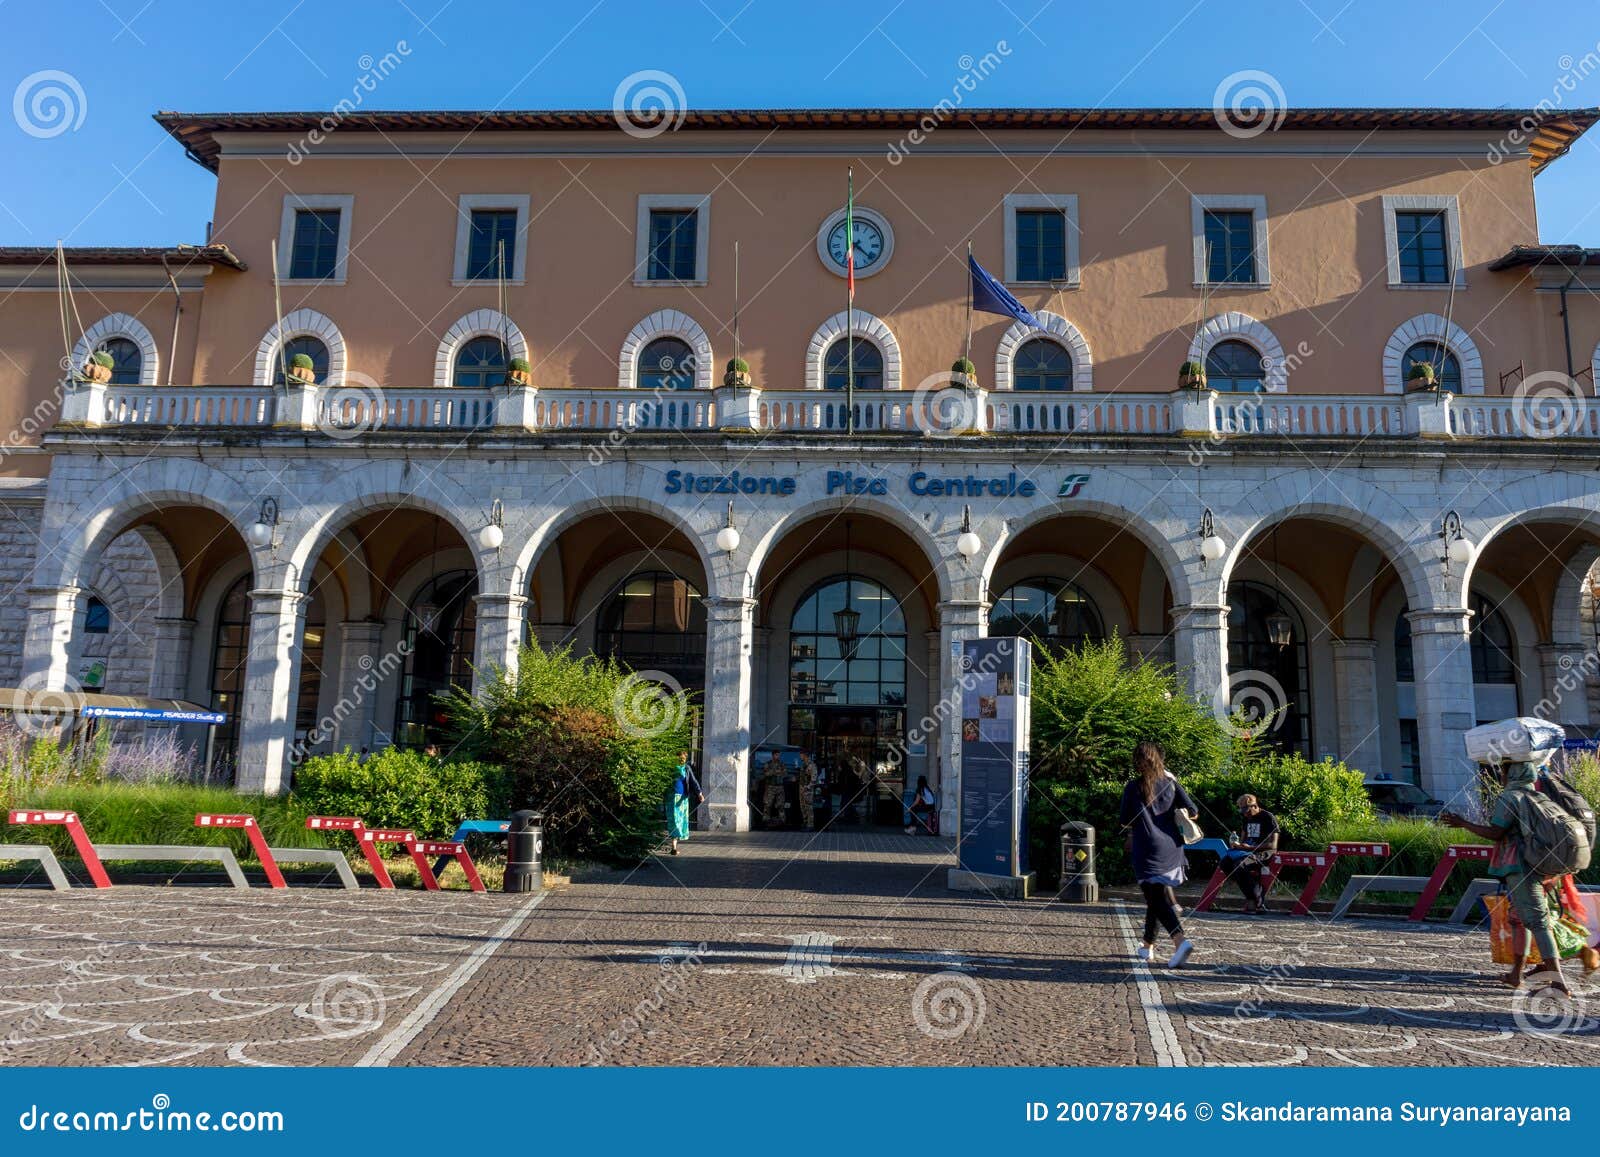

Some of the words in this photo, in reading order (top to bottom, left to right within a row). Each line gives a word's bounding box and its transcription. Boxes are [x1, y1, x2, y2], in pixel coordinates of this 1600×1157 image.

[664, 469, 797, 494] Stazione
[826, 470, 888, 495] Pisa
[908, 471, 1037, 497] Centrale
[102, 709, 144, 718] Aeroporto
